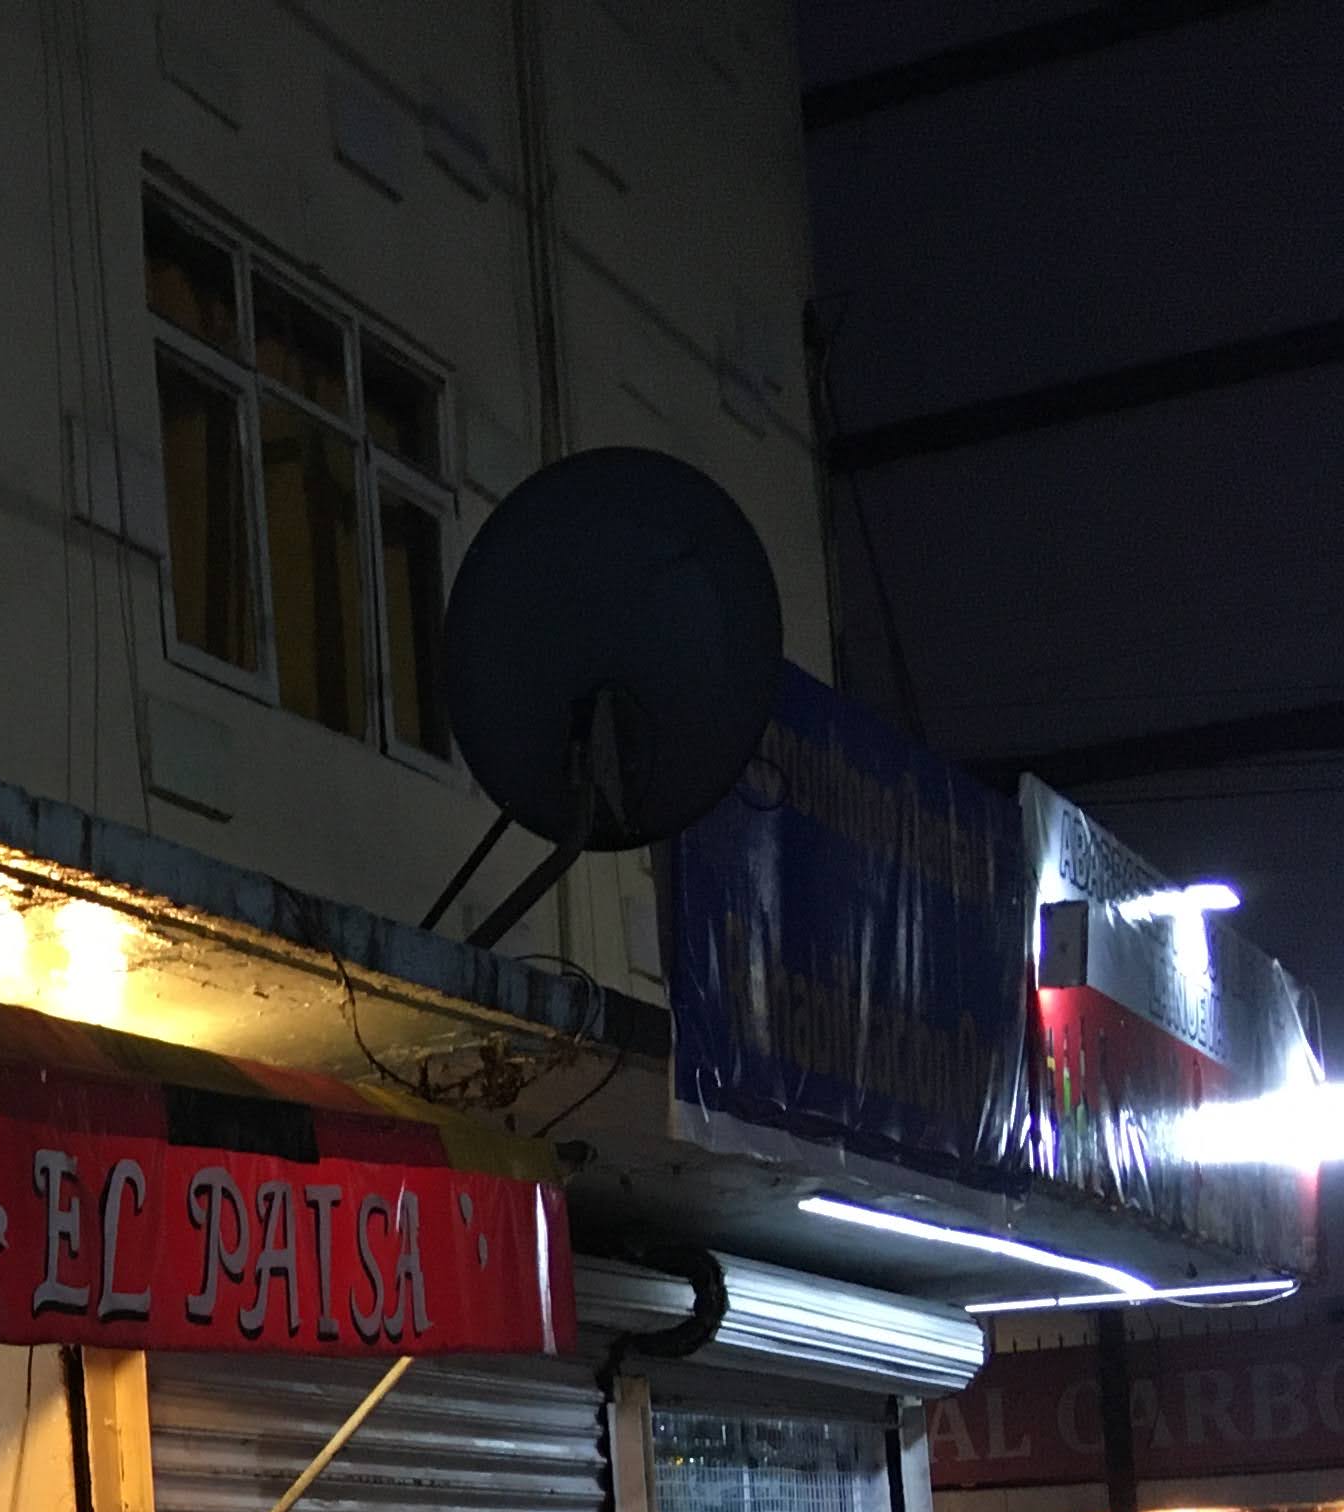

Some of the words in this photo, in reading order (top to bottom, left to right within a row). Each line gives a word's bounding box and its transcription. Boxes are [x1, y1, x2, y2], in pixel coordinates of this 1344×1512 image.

[32, 1149, 152, 1321] EL
[186, 1167, 433, 1343] PAISA
[930, 1386, 1031, 1462] AL
